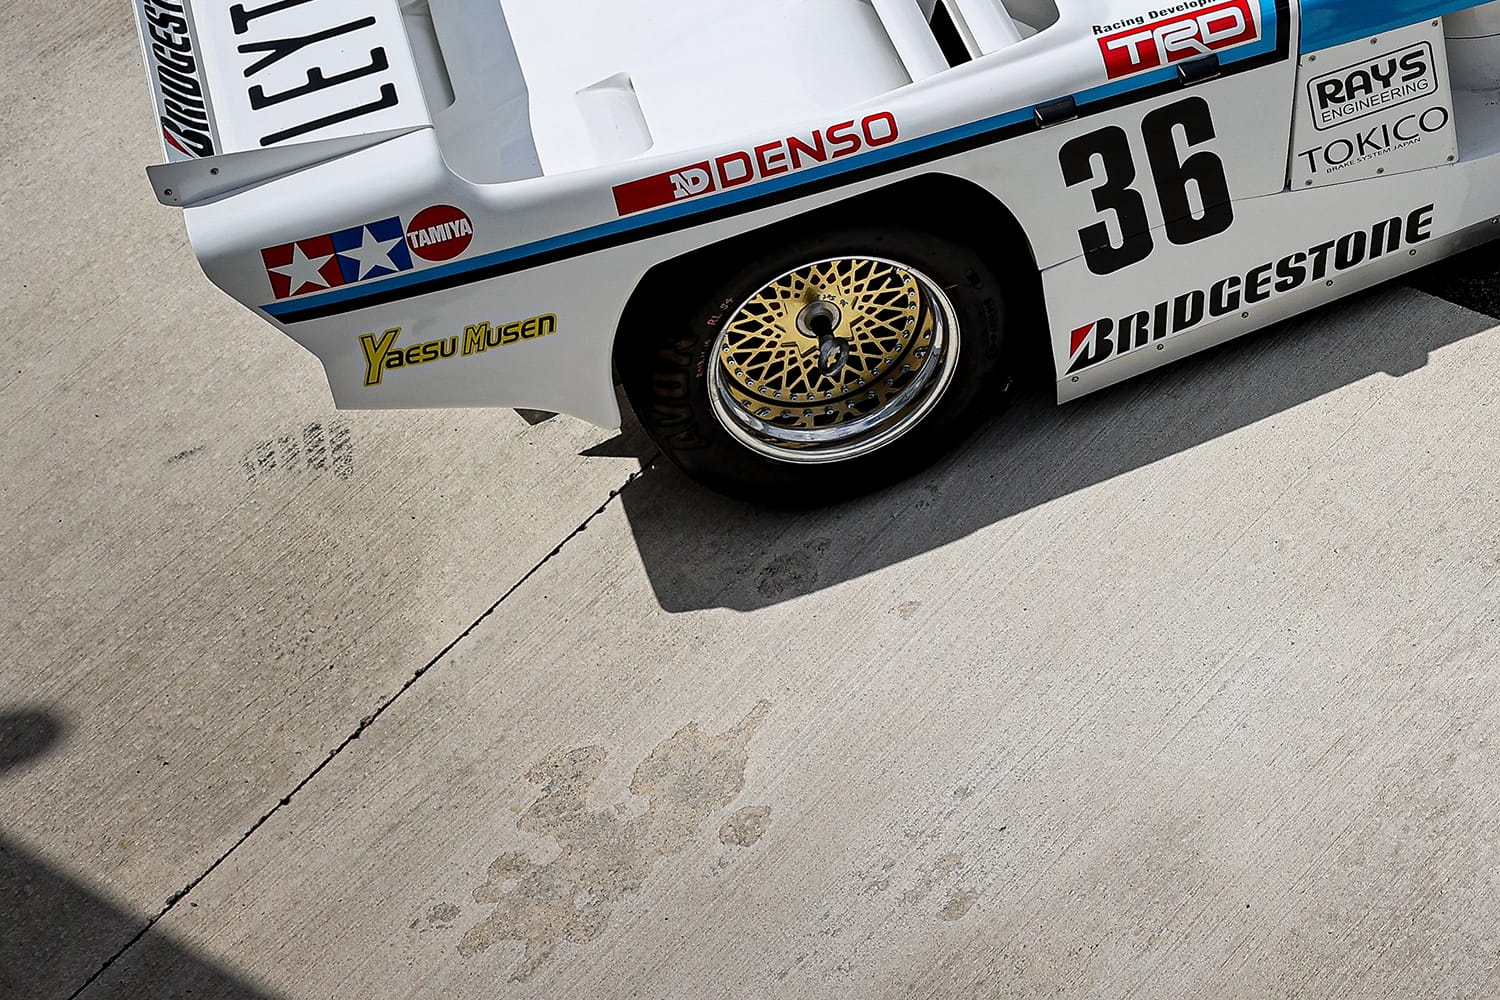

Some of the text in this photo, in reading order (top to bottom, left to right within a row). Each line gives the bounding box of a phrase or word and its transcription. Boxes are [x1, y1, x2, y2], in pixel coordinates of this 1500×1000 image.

[1092, 15, 1145, 36] Racing
[1106, 6, 1246, 65] TRD
[1316, 49, 1427, 110] RAYS
[1321, 78, 1429, 123] ENGINEERING
[715, 111, 899, 190] DENSO
[1298, 106, 1449, 174] TOKICO
[1326, 136, 1422, 174] BRAKE SYSTEM JAPAN
[1058, 96, 1235, 276] 36
[407, 217, 473, 250] TAMIYA
[1064, 203, 1434, 375] BRIDGESTONE
